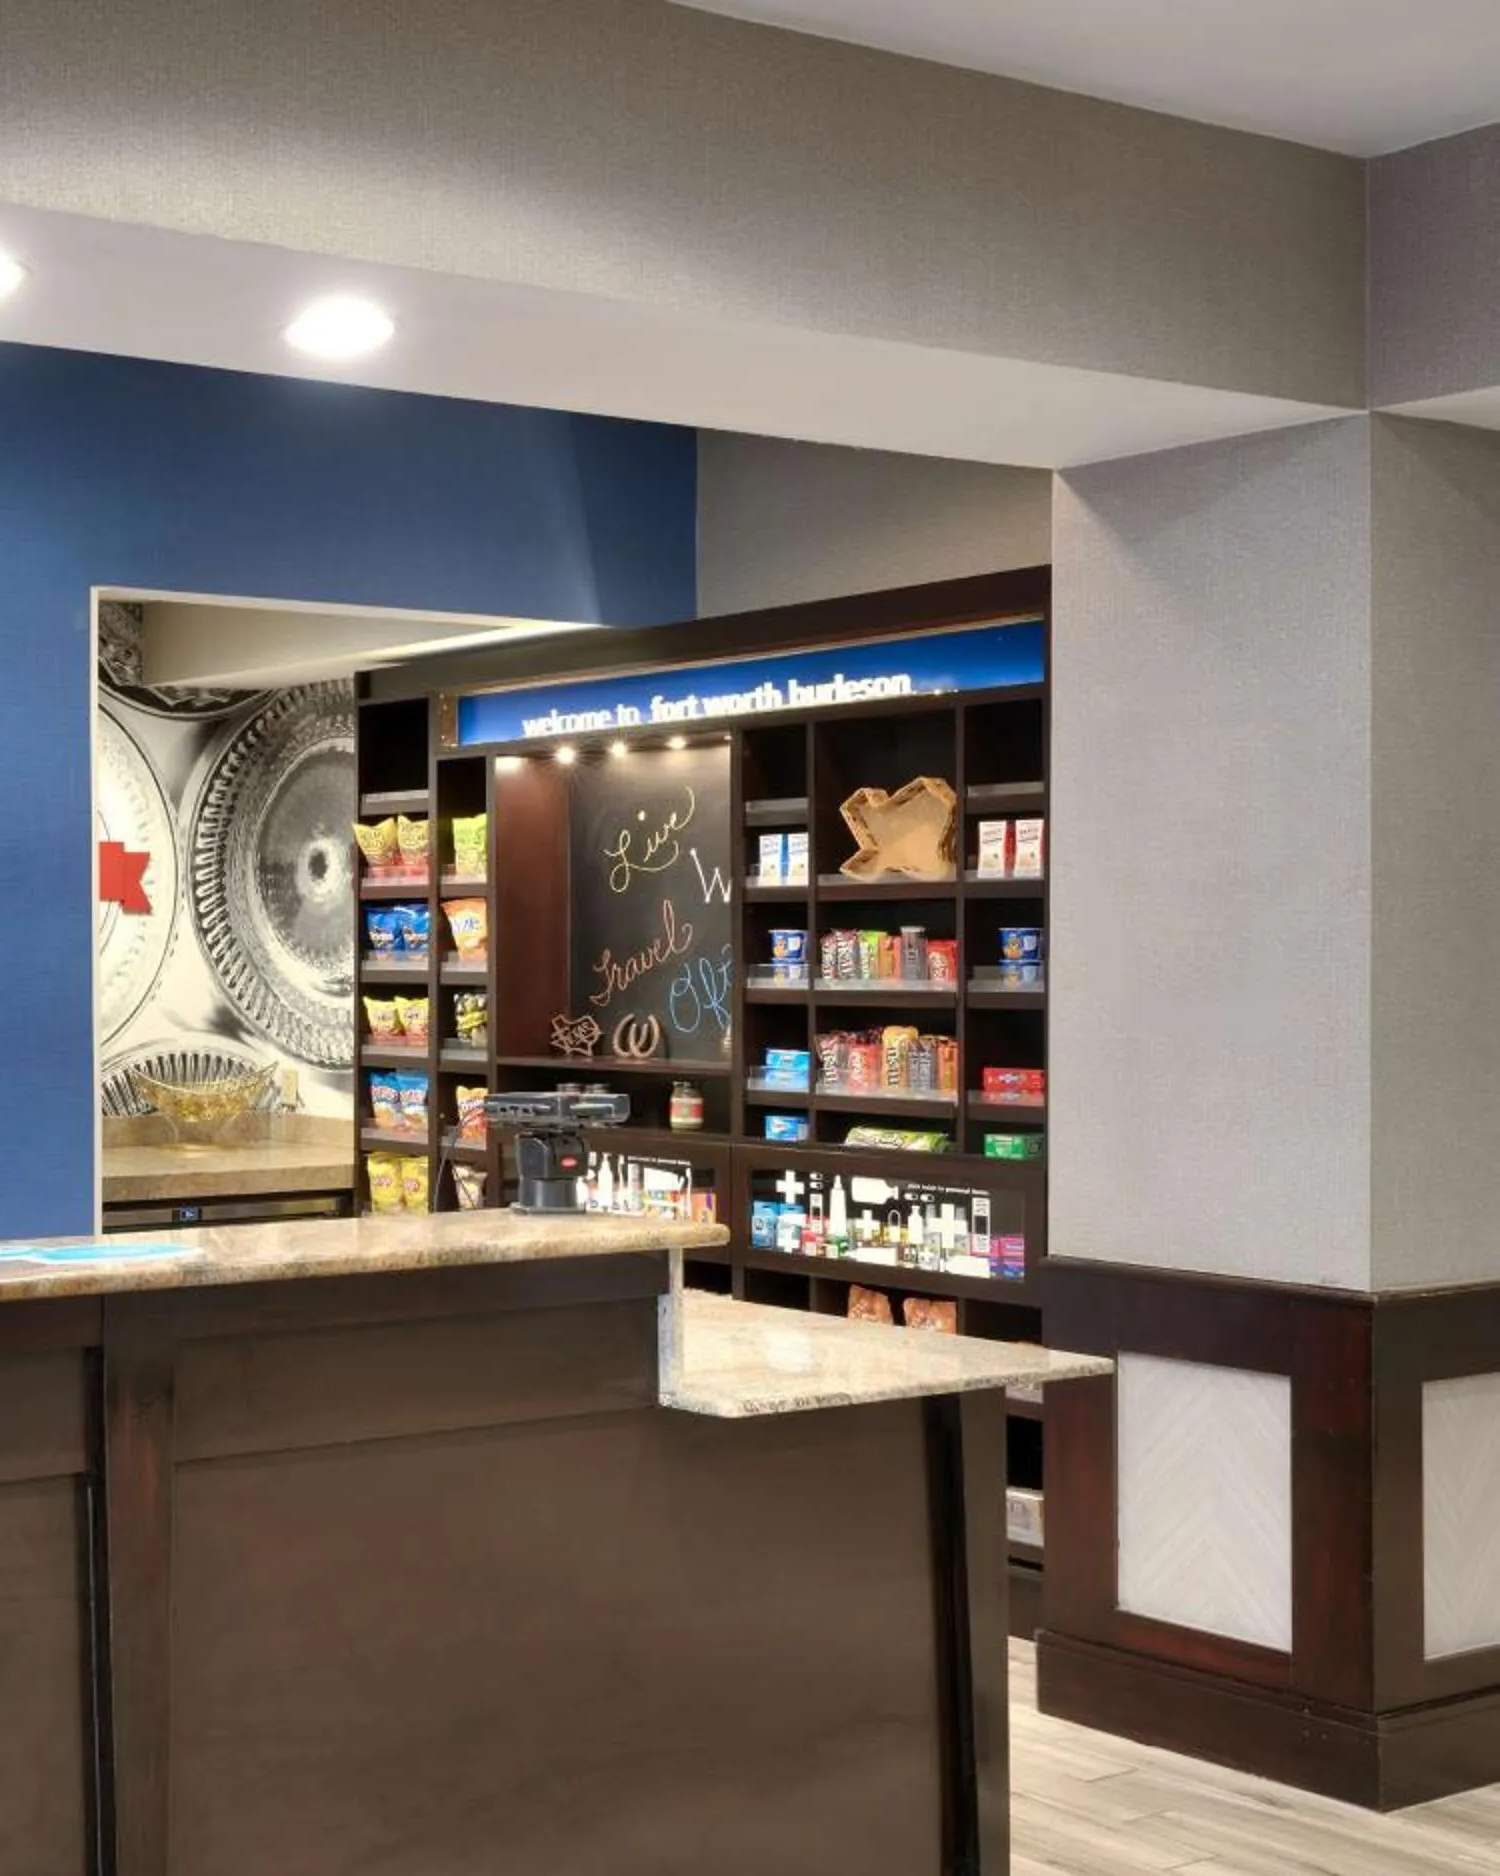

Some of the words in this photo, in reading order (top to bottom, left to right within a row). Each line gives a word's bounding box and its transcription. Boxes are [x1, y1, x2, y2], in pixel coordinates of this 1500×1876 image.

[522, 709, 612, 738] welcome
[616, 703, 641, 727] to
[649, 694, 700, 724] fort
[701, 682, 784, 718] worth
[787, 673, 913, 706] burleson
[603, 785, 695, 893] Live
[589, 899, 693, 1006] Travel
